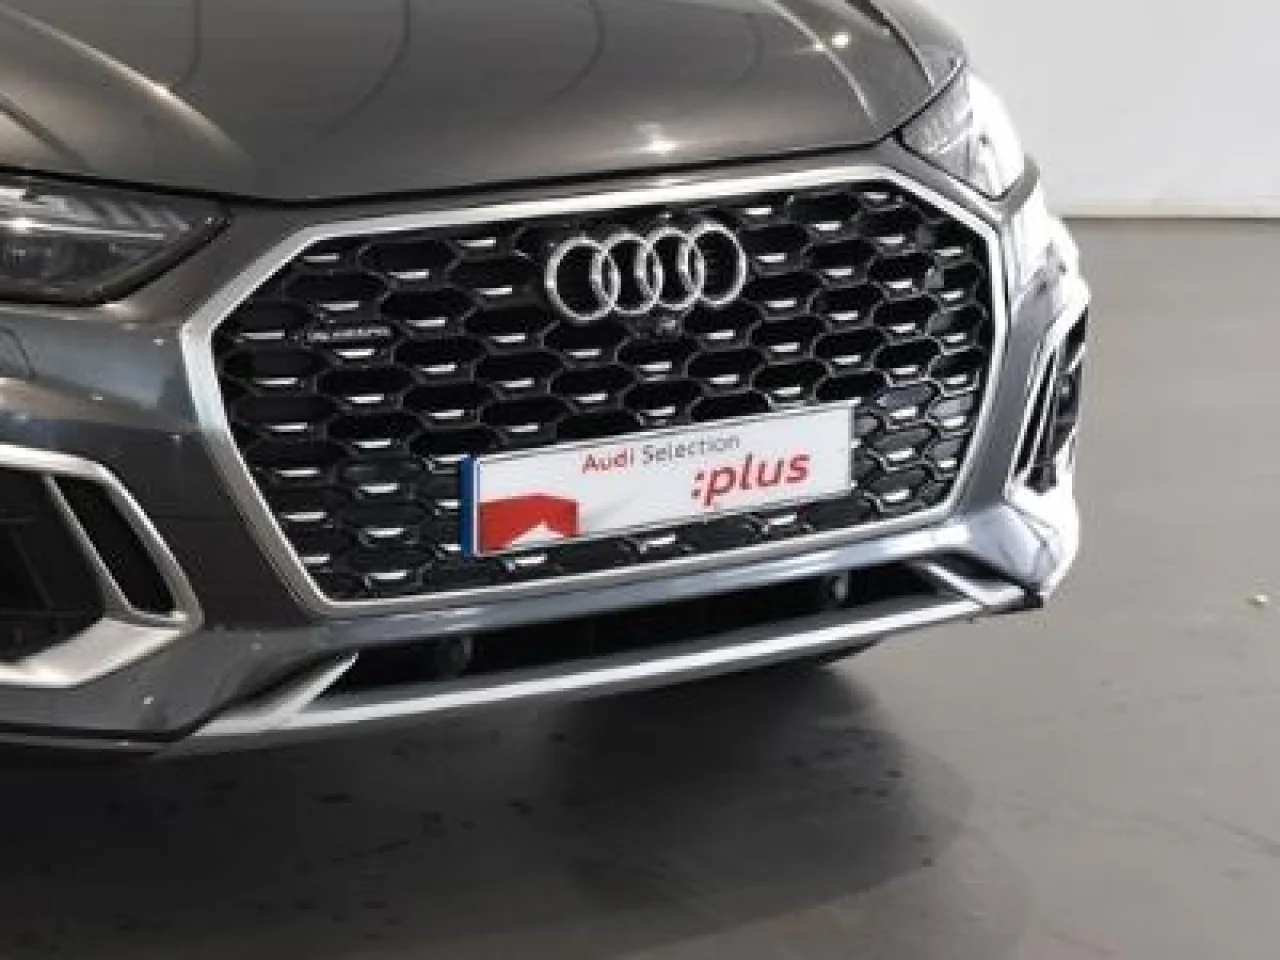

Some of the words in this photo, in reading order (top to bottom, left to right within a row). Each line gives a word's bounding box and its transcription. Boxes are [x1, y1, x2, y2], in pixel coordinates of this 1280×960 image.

[581, 447, 634, 474] Audi
[642, 435, 741, 465] Selection
[690, 452, 811, 507] :plus
